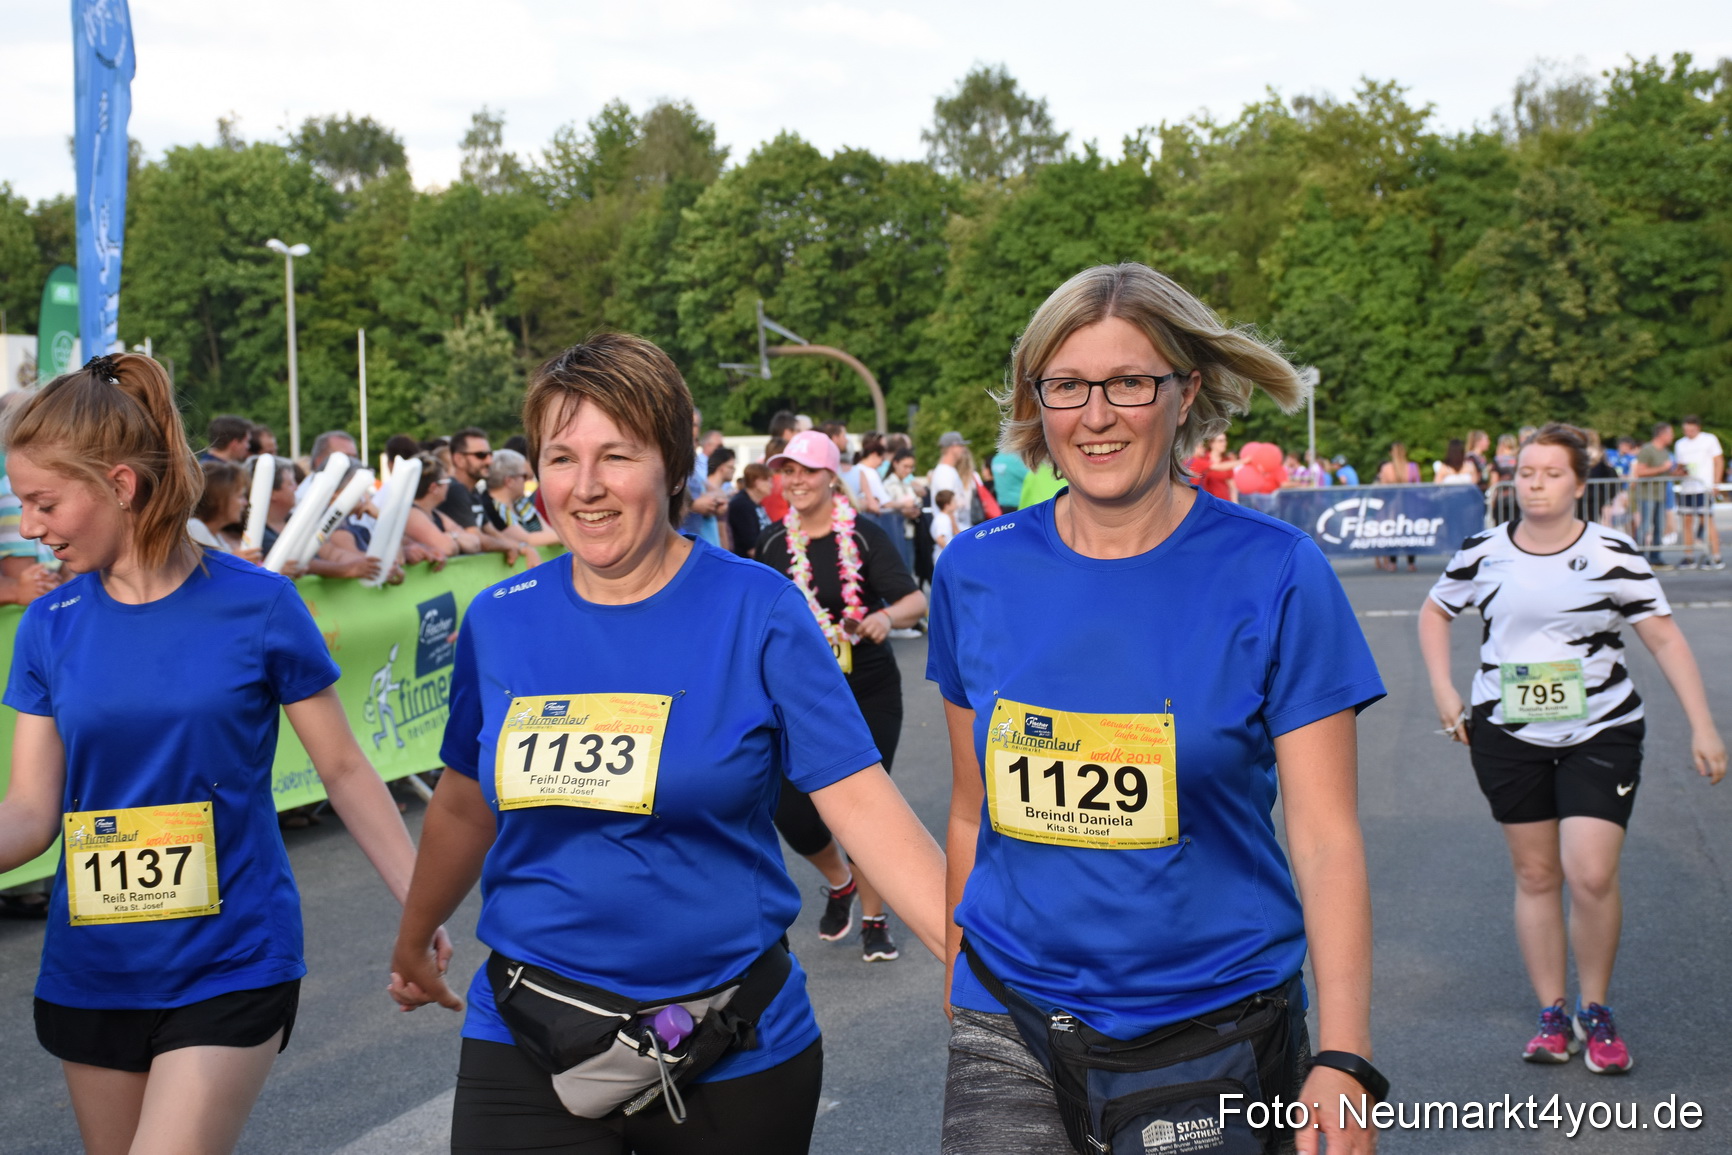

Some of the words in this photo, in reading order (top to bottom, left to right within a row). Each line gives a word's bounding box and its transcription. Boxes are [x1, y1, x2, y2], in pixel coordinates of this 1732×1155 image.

[989, 522, 1016, 535] JAKO
[1340, 512, 1444, 538] Fischer
[1349, 536, 1436, 549] AUTOMOBILE
[508, 579, 537, 594] JAKO
[61, 595, 81, 608] JAKO
[1517, 683, 1565, 705] 795
[528, 715, 590, 725] firmenlauf
[594, 720, 623, 732] walk
[623, 724, 655, 734] 2019
[1100, 718, 1133, 730] Gesunde
[1012, 731, 1081, 752] firmenlauf
[518, 733, 636, 775] 1133
[1091, 748, 1124, 763] walk
[1126, 753, 1162, 764] 2019
[529, 774, 558, 785] Feihl
[561, 775, 611, 787] Dagmar
[1009, 756, 1148, 813] 1129
[540, 786, 555, 794] Kita
[570, 787, 594, 796] Josef
[1025, 807, 1074, 823] Breindl
[1079, 812, 1133, 827] Daniela
[1047, 823, 1065, 832] Kita
[1068, 825, 1080, 834] St.
[1083, 827, 1110, 836] Josef
[86, 830, 139, 845] firmenlauf
[146, 832, 173, 846] walk
[175, 833, 203, 844] 2019
[84, 846, 192, 891] 1137
[103, 892, 126, 904] Reiß
[130, 890, 176, 902] Ramona
[114, 904, 129, 912] Kita
[143, 902, 164, 910] Josef
[1176, 1117, 1219, 1133] STADT-
[1179, 1127, 1222, 1141] APOTHEKE
